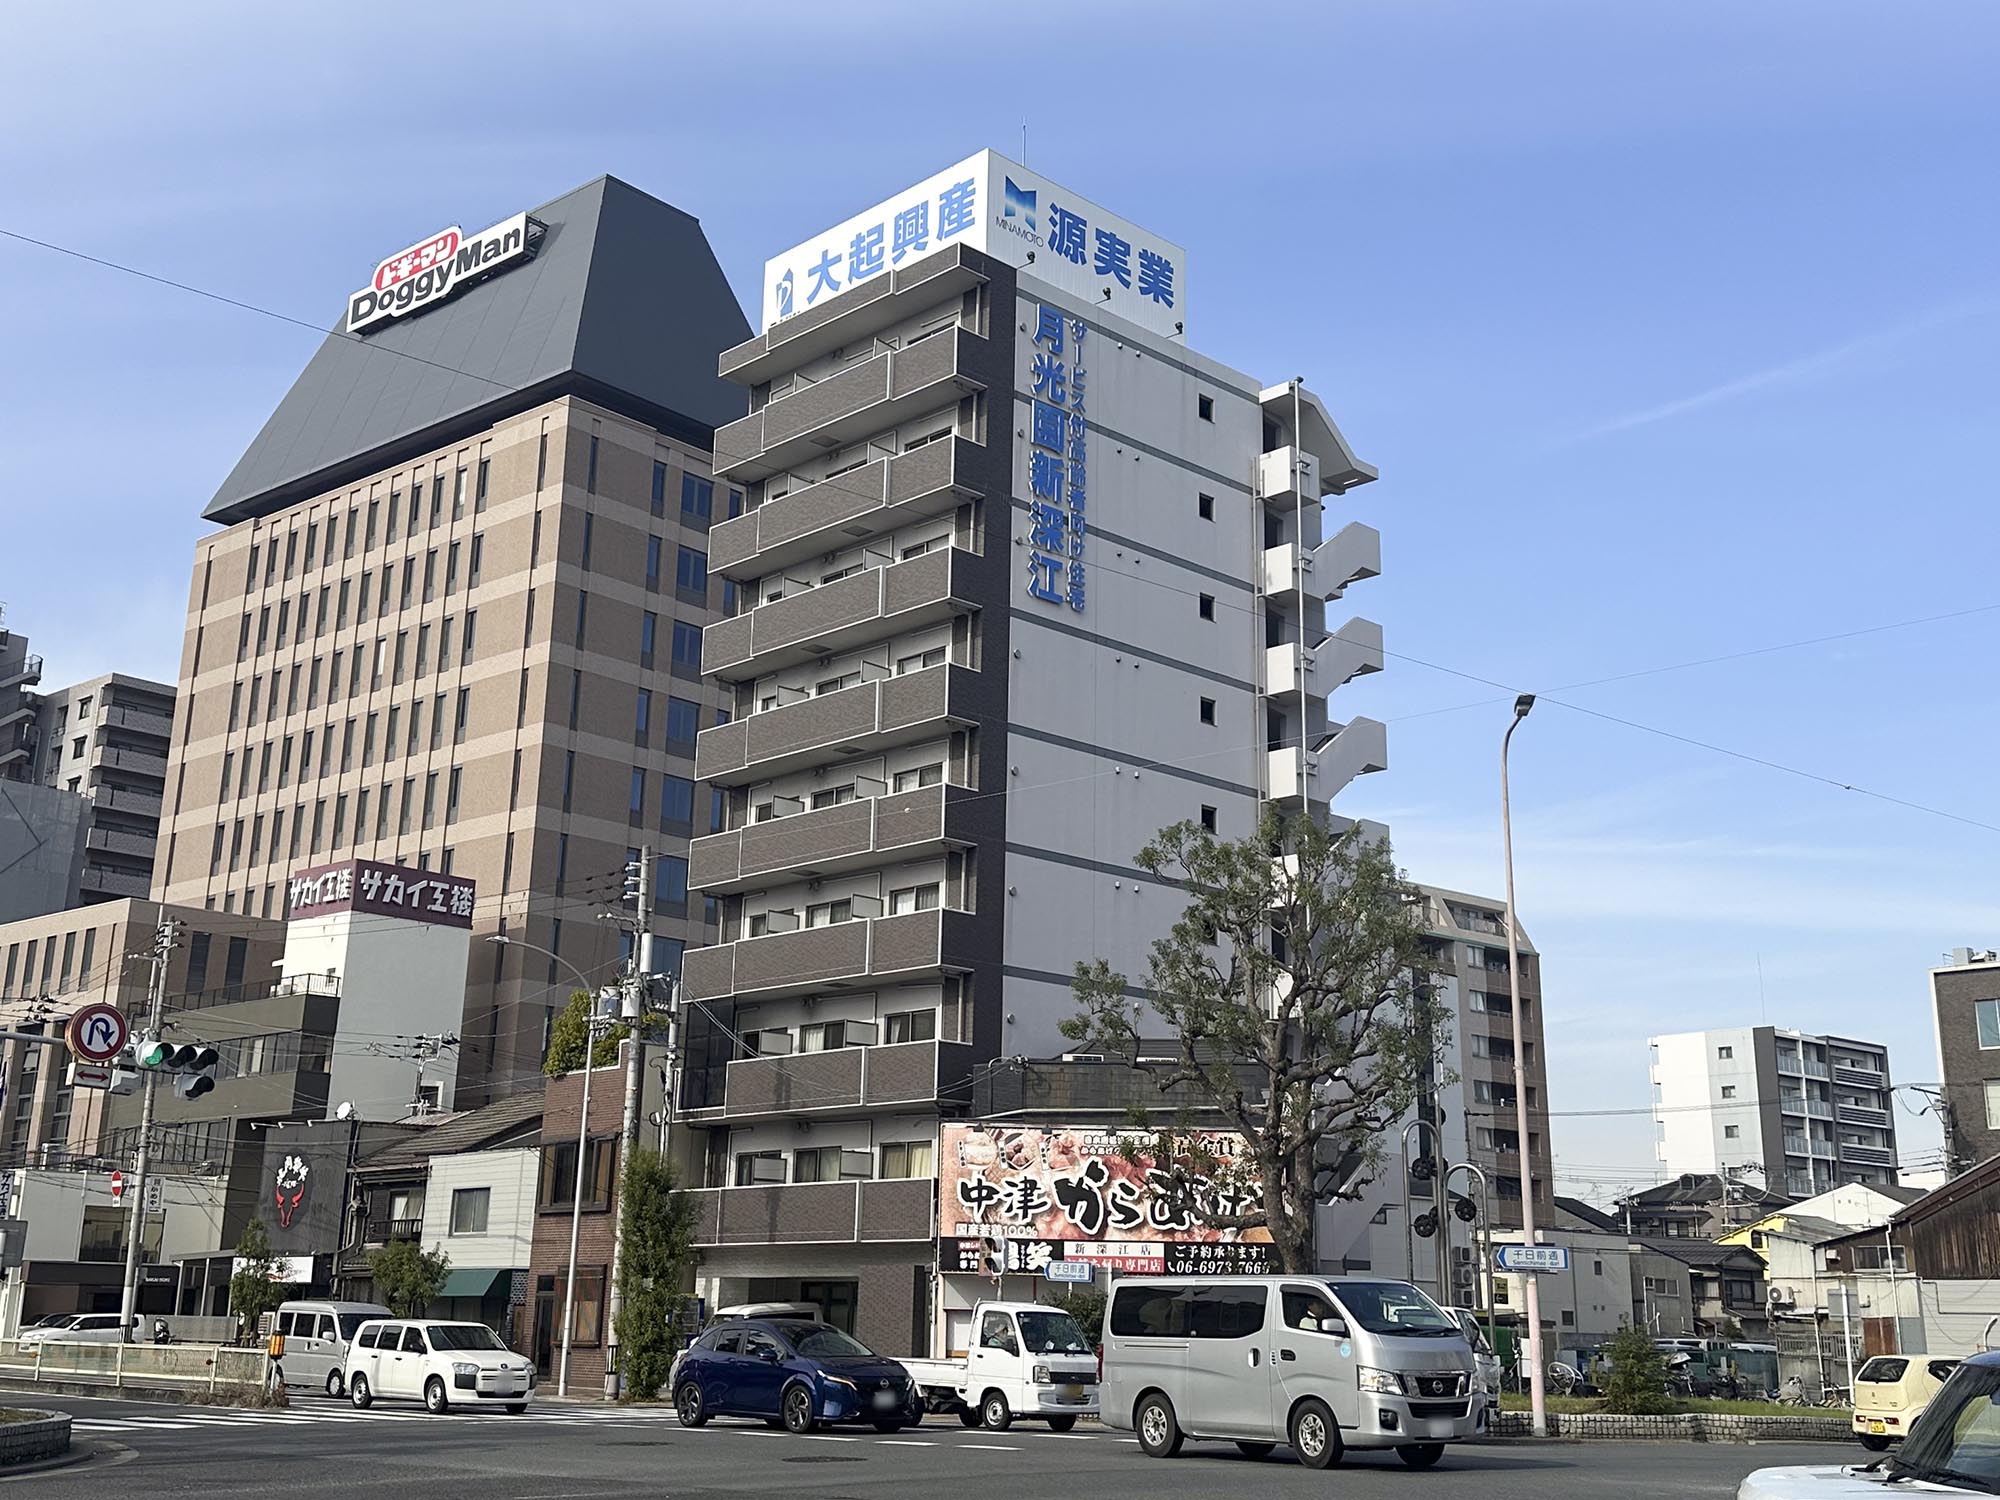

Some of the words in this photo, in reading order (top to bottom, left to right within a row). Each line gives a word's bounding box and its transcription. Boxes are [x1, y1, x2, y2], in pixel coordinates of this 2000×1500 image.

[380, 234, 453, 290] ドギーマン
[806, 177, 976, 304] 大起興産
[996, 216, 1044, 248] MINAMOTO
[1048, 202, 1174, 309] 源実業
[350, 227, 520, 324] DoggyMan
[1027, 303, 1066, 604] 月光園新深江
[1055, 1263, 1085, 1274] 千日前通
[1513, 1249, 1558, 1261] 千日前通
